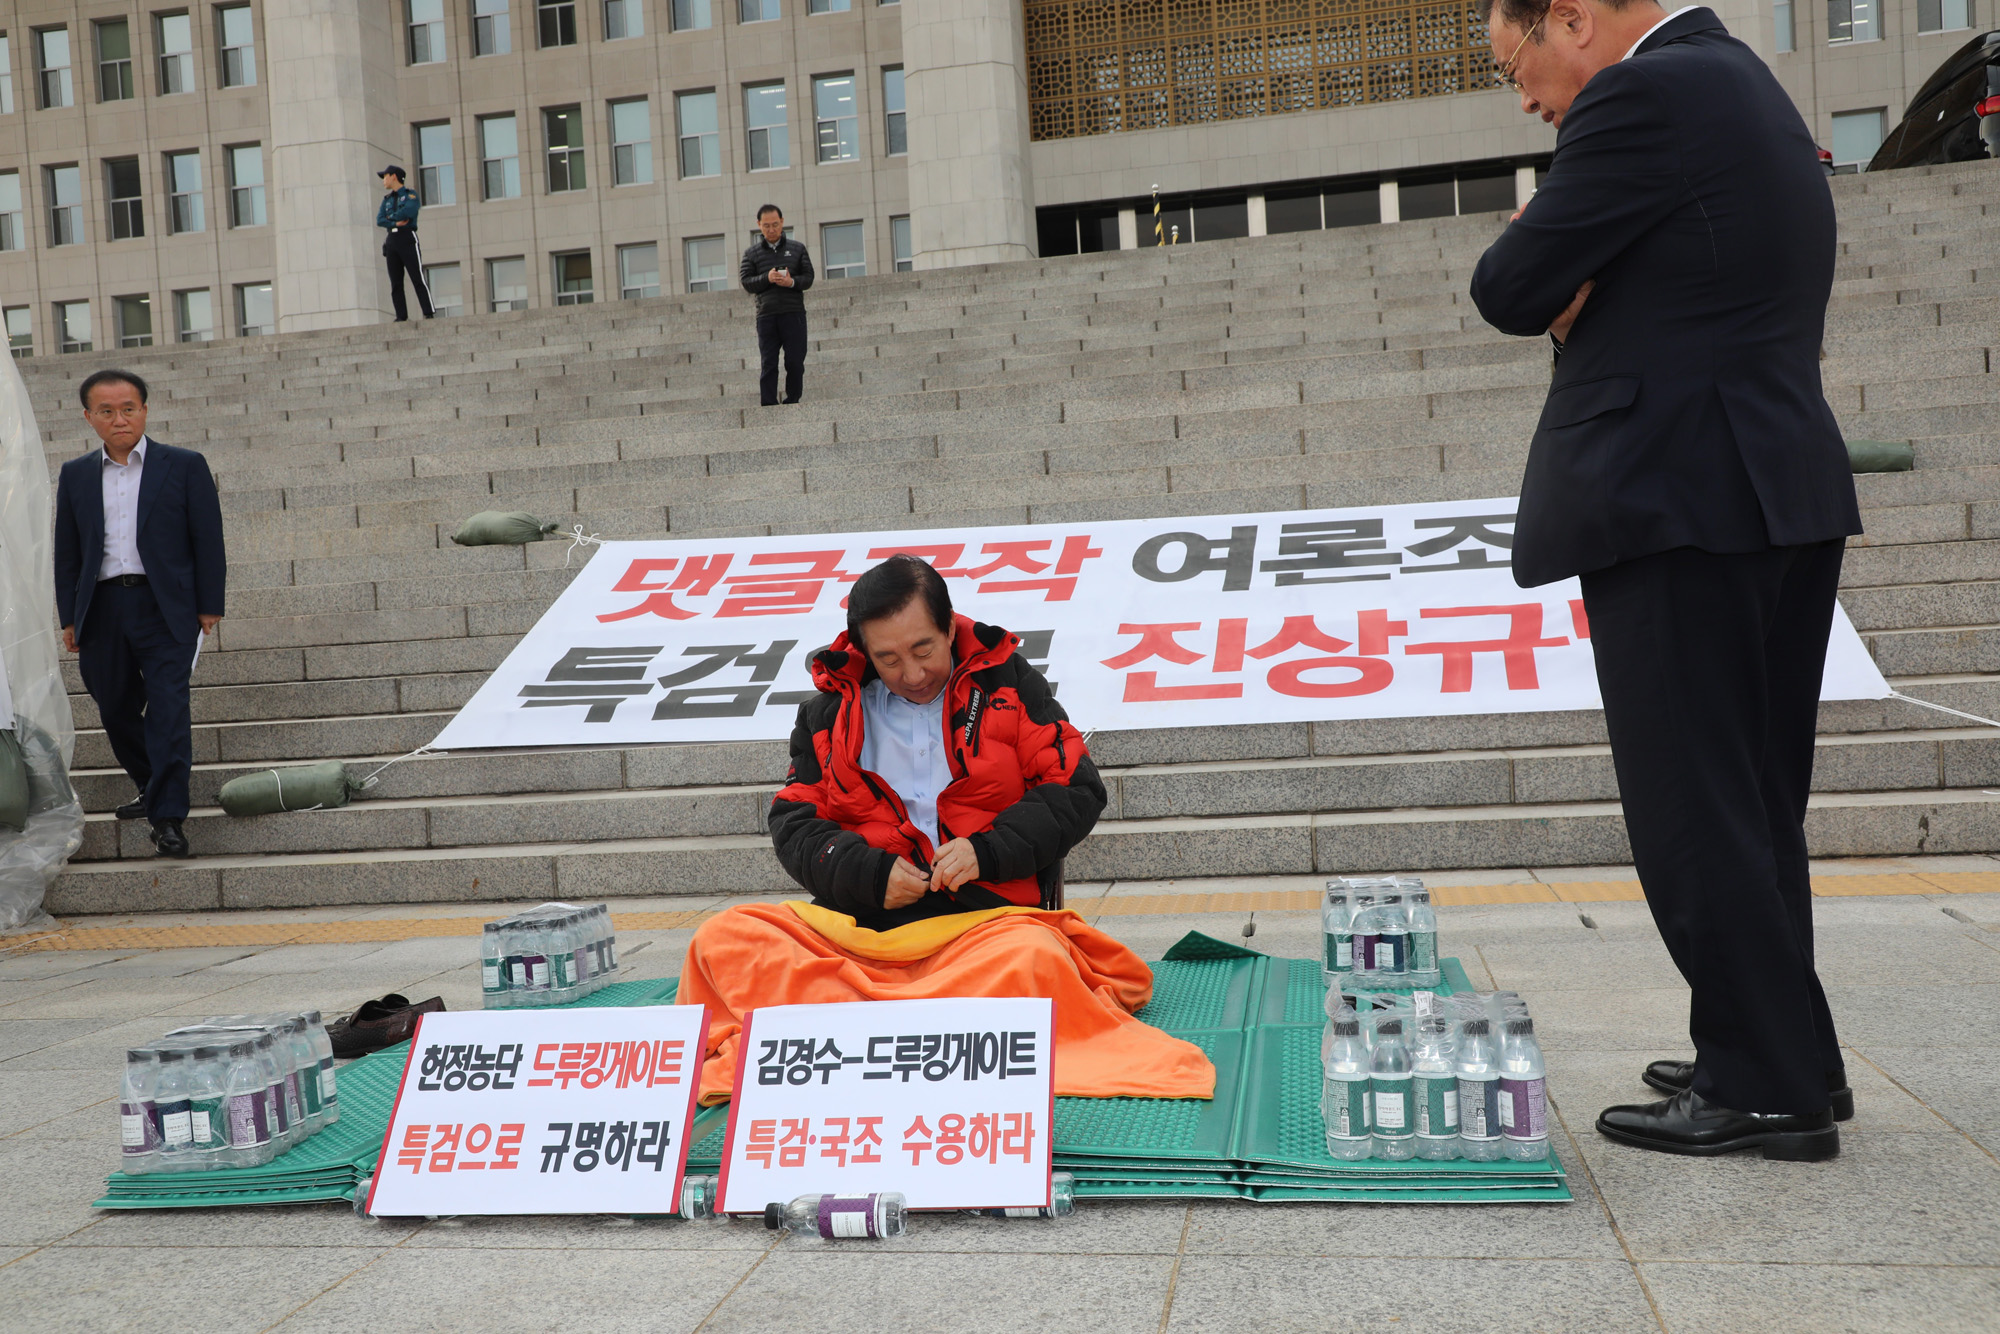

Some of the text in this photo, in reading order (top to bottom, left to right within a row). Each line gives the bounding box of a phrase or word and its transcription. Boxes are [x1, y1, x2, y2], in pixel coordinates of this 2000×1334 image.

[1099, 599, 1591, 702] 진상규
[968, 689, 981, 722] EXTREME
[418, 1040, 685, 1091] 헌정농단 드루킹게이트
[397, 1121, 670, 1174] 특검으로 규명하라
[902, 1112, 1036, 1166] 수용하라
